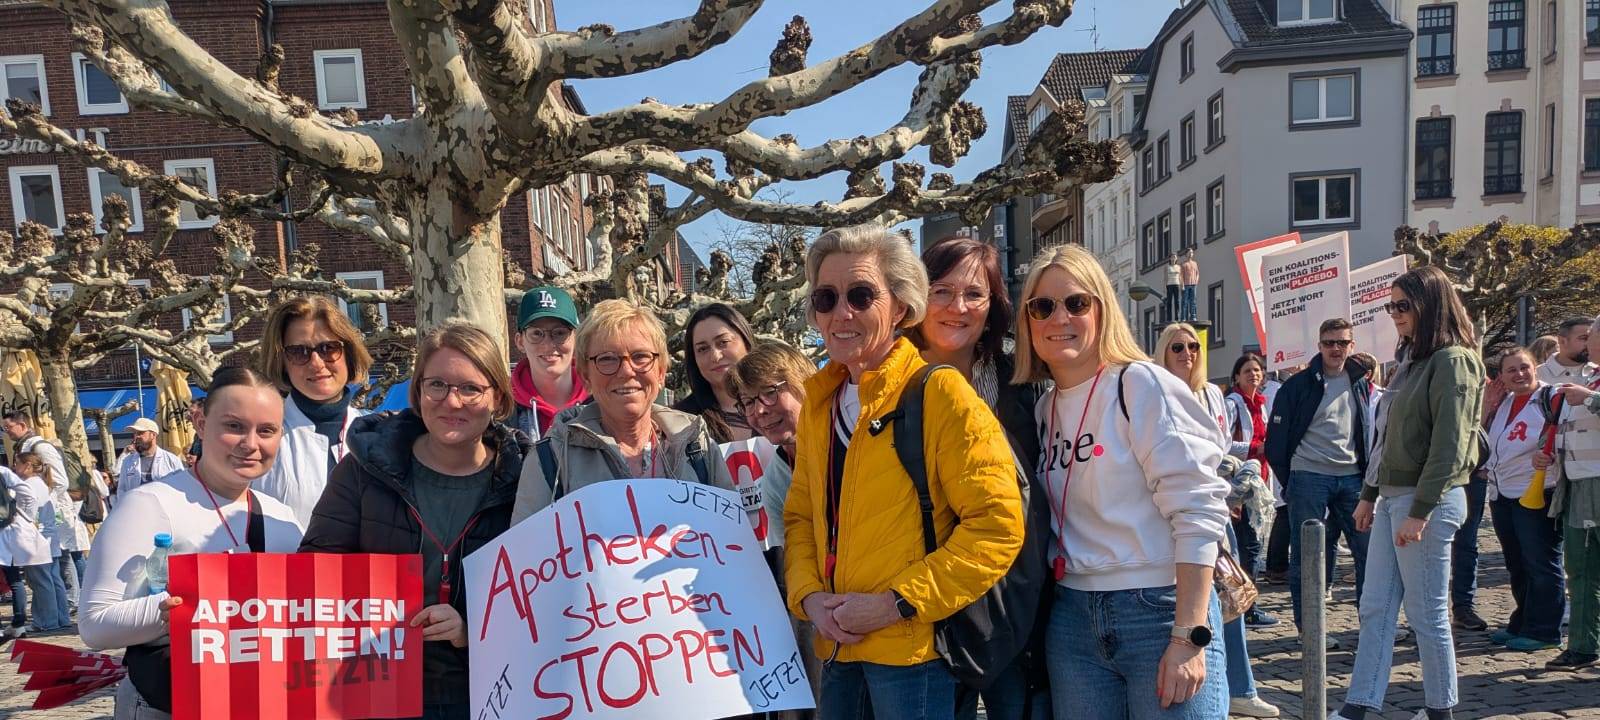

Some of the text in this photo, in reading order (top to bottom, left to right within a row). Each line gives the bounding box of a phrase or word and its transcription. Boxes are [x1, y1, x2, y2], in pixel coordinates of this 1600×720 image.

[1269, 252, 1340, 276] EIN KOALITIONS-
[1269, 264, 1325, 285] VERTRAG IST
[1270, 271, 1336, 293] KEIN PLACEBO.
[1350, 282, 1388, 298] ERTRAG IST
[1358, 272, 1400, 288] KOALITIONS-
[539, 290, 557, 308] LA
[1271, 291, 1325, 310] JETZT WORT
[1271, 305, 1306, 319] HALTEN!
[1351, 311, 1367, 320] ETZT
[1351, 316, 1375, 327] ALTEN!
[667, 482, 746, 525] JETZT
[480, 484, 744, 643] Apotheken-
[191, 598, 405, 624] APOTHEKEN
[562, 579, 732, 642] sterben
[191, 626, 405, 664] RETTEN!
[532, 624, 765, 720] STOPPEN
[749, 651, 806, 708] JETZT
